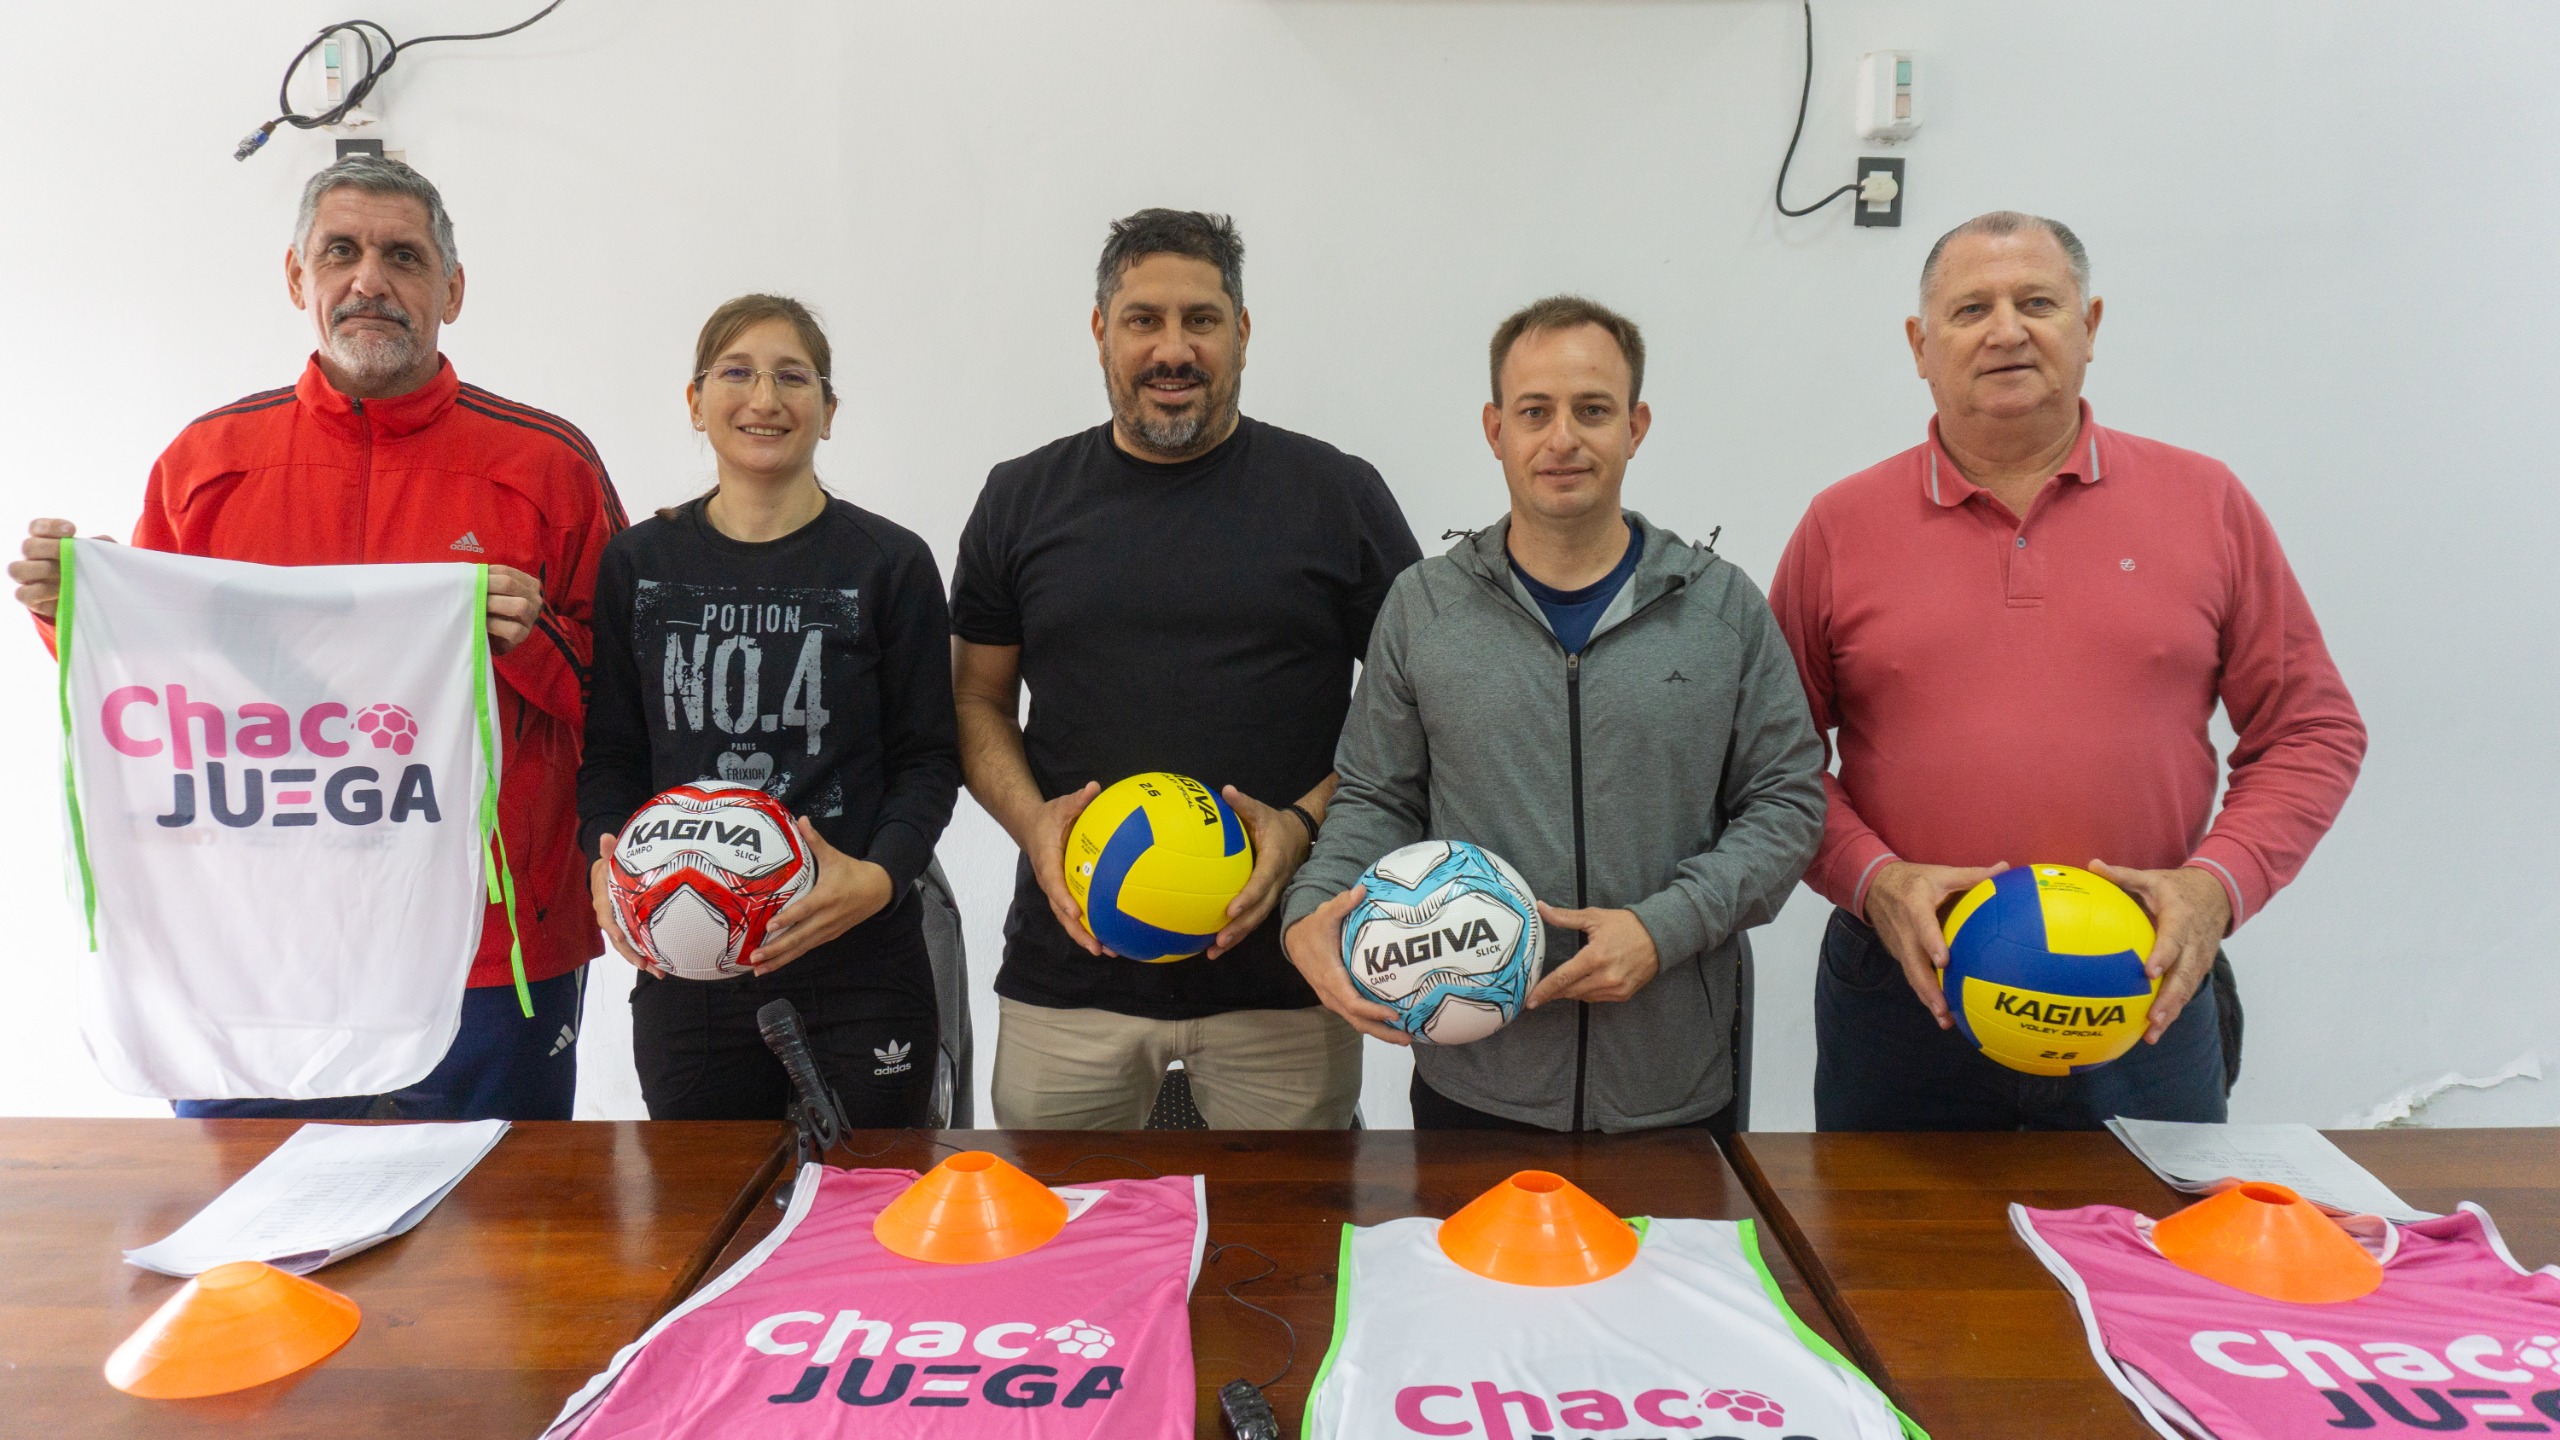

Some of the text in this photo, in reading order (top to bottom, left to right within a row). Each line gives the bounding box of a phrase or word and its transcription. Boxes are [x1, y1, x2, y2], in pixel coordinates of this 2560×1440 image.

[450, 543, 485, 553] adidas
[701, 604, 801, 633] POTION
[663, 629, 830, 756] NO.4
[731, 742, 757, 751] PARIS
[726, 768, 765, 781] FRIXION
[156, 762, 442, 828] JUEGA
[1138, 782, 1162, 797] 2.6
[627, 819, 762, 854] KAGIVA
[626, 845, 761, 863] CAMPO SLICK
[1364, 917, 1499, 975] KAGIVA
[1475, 944, 1501, 957] SLICK
[1370, 973, 1397, 985] CAMPO
[1994, 991, 2126, 1027] KAGIVA
[2020, 1022, 2060, 1035] VOLEY
[2040, 1050, 2079, 1060] 2.6
[874, 1061, 912, 1076] adidas
[767, 1357, 1124, 1408] JUEGA
[2320, 1382, 2560, 1433] JUE
